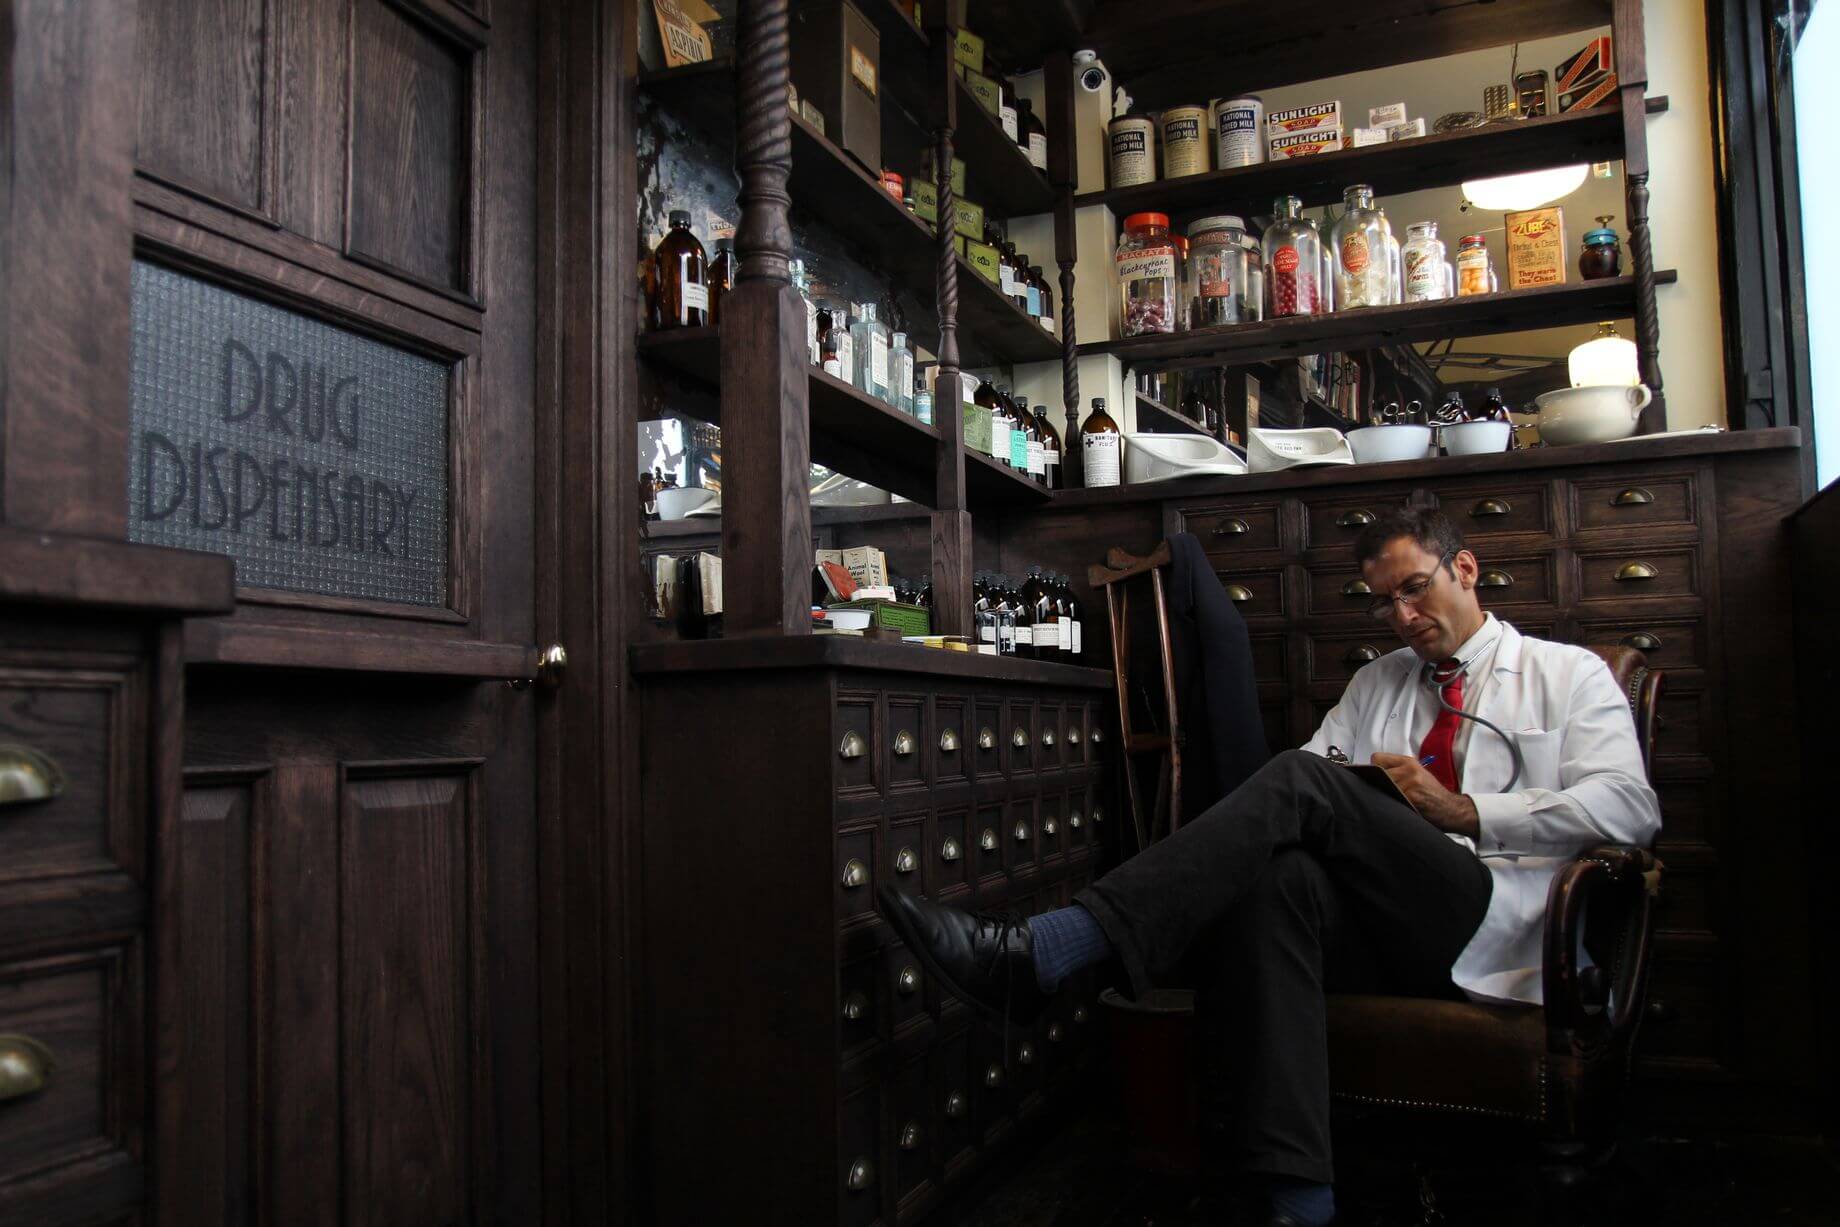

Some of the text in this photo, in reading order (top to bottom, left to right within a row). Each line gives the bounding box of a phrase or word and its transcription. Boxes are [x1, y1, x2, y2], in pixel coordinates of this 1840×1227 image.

[669, 25, 704, 62] ASPIRIN
[1222, 111, 1251, 121] NATIONAL
[1271, 103, 1334, 125] SUNLIGHT
[1167, 120, 1195, 131] NATIONAL
[1239, 119, 1254, 129] MILK
[1112, 132, 1141, 144] NATIONAL
[1182, 128, 1197, 138] MILK
[1128, 141, 1143, 150] MILK
[1273, 131, 1336, 152] SUNLIGHT
[1119, 258, 1169, 276] Blackcurrant
[1144, 267, 1162, 277] Pops
[1519, 270, 1535, 279] They
[1534, 274, 1556, 282] Chest
[222, 337, 359, 451] DRUG
[140, 430, 415, 555] DISPENSARY
[848, 563, 866, 571] Animal
[851, 569, 865, 577] Wool
